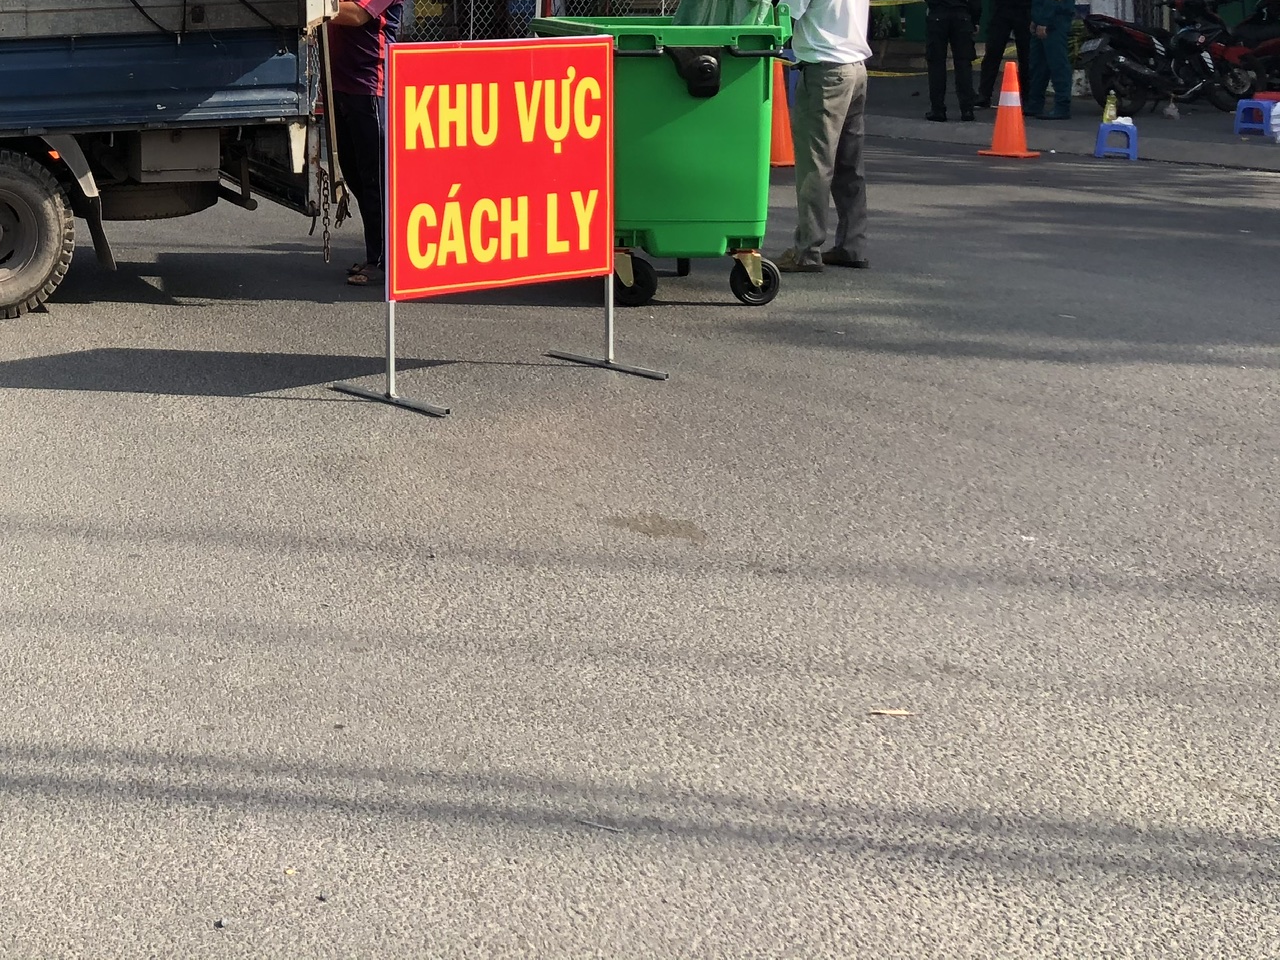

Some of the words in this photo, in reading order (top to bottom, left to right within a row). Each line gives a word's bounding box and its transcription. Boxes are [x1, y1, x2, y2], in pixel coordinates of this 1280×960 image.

[404, 83, 498, 150] KHU
[514, 66, 601, 154] VỰC
[407, 183, 528, 269] CÁCH
[546, 189, 599, 254] LY
